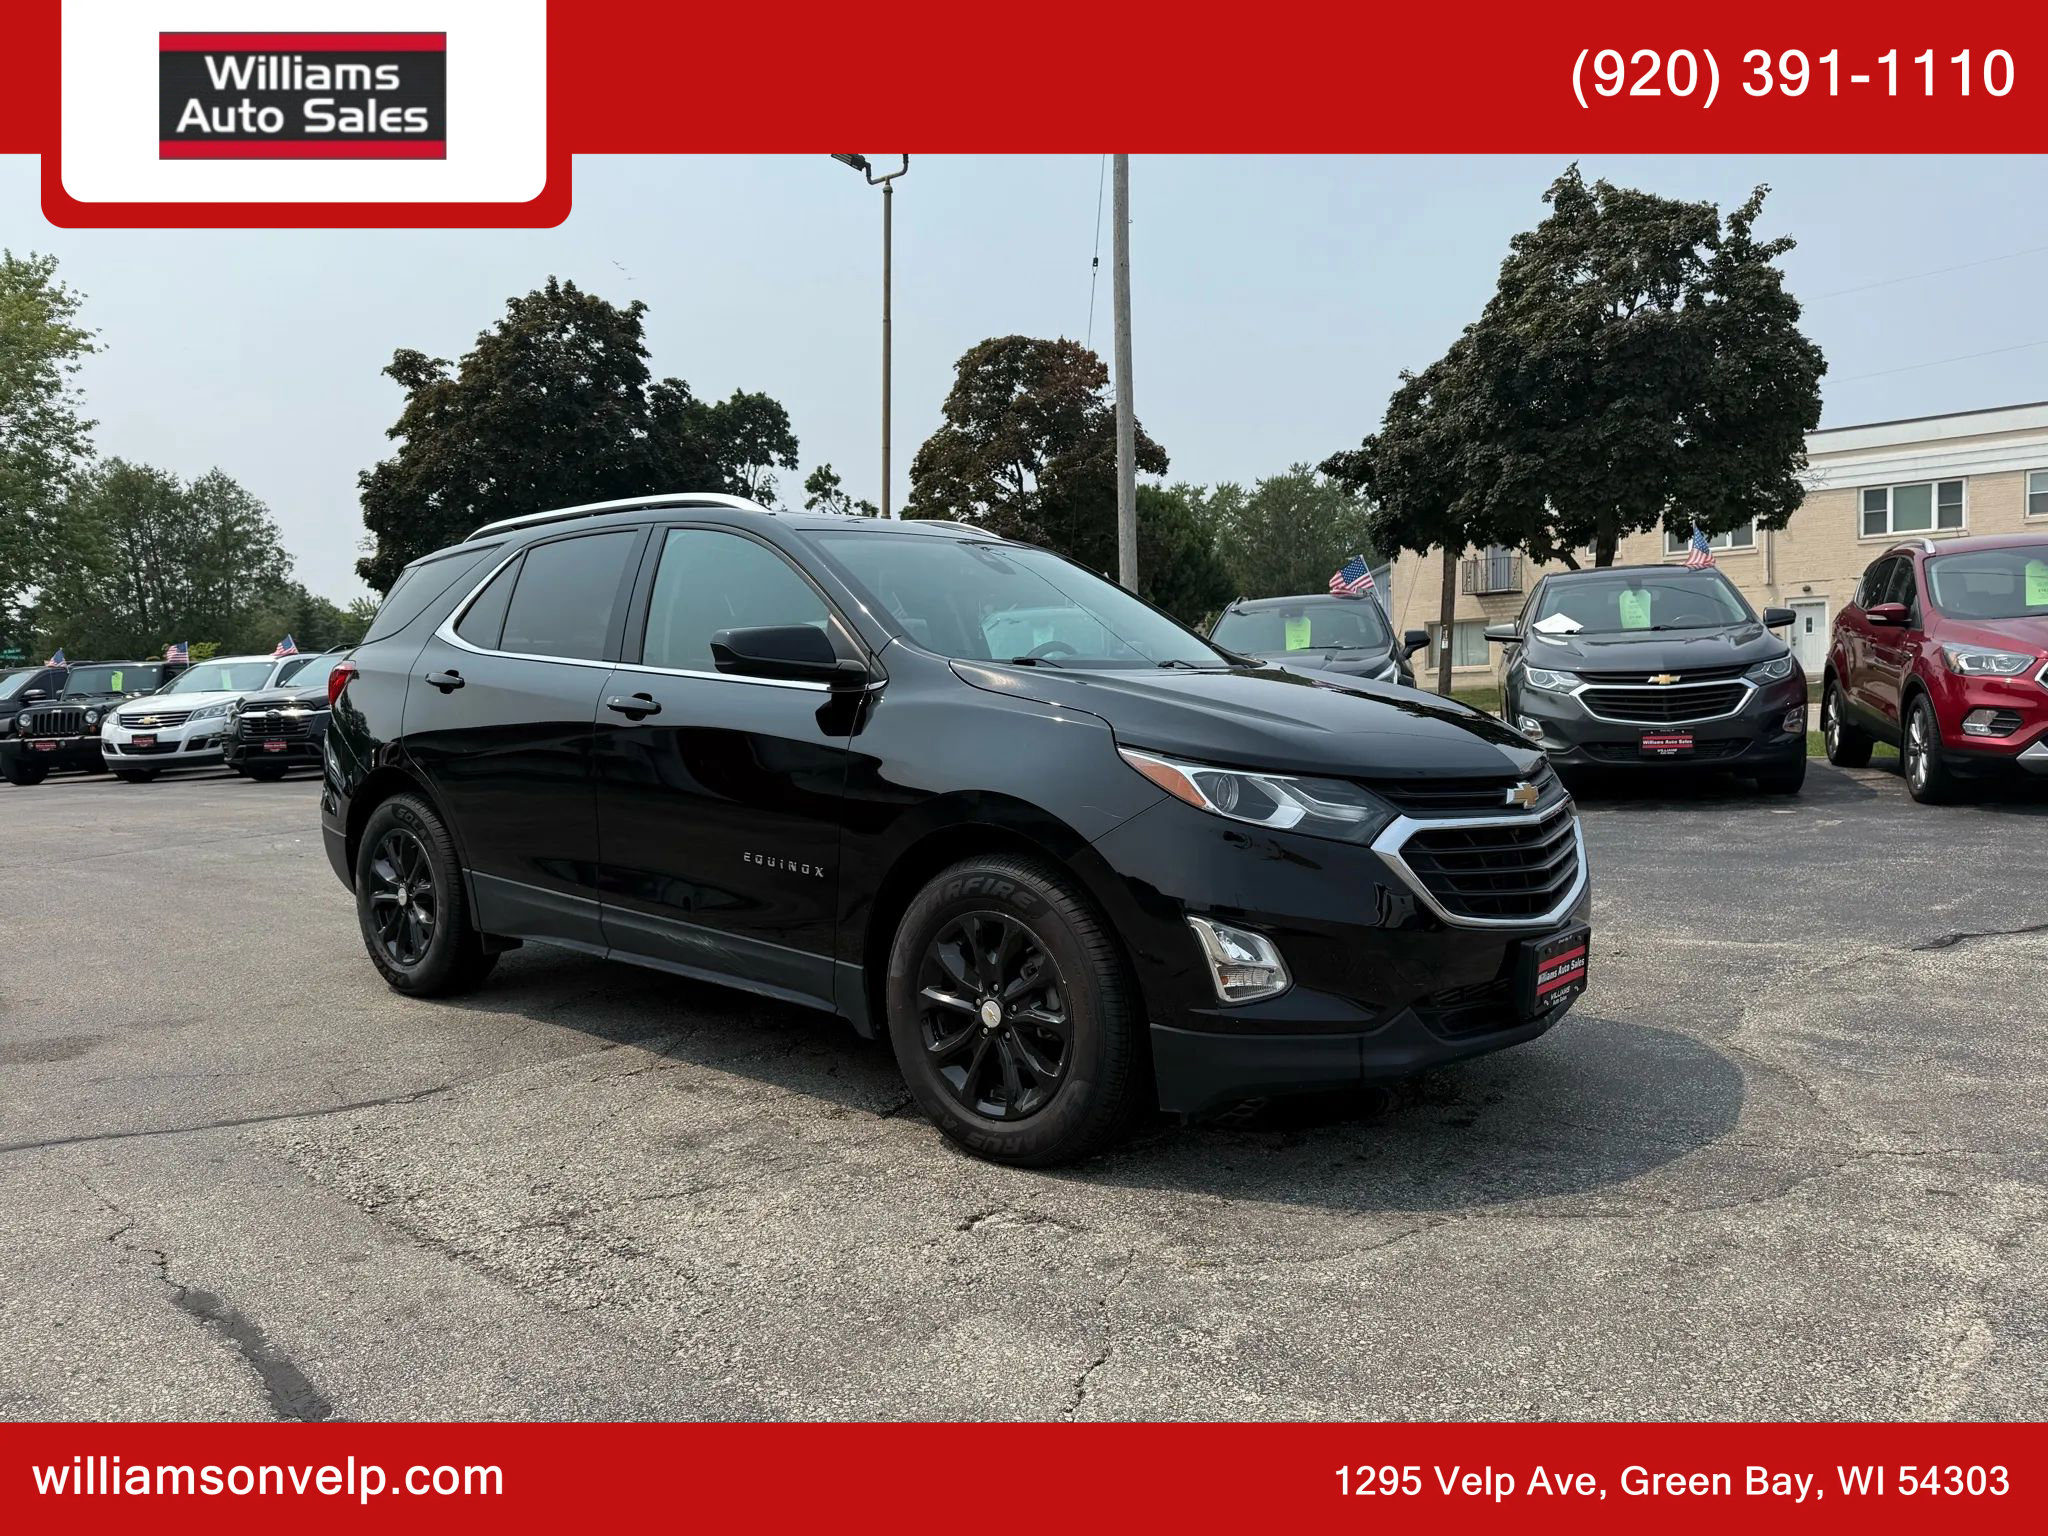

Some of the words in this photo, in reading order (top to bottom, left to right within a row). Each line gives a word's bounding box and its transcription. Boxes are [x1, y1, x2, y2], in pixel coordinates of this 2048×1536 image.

[744, 852, 824, 878] EQUINOX
[1558, 964, 1571, 976] Auto
[1571, 957, 1585, 971] Sales
